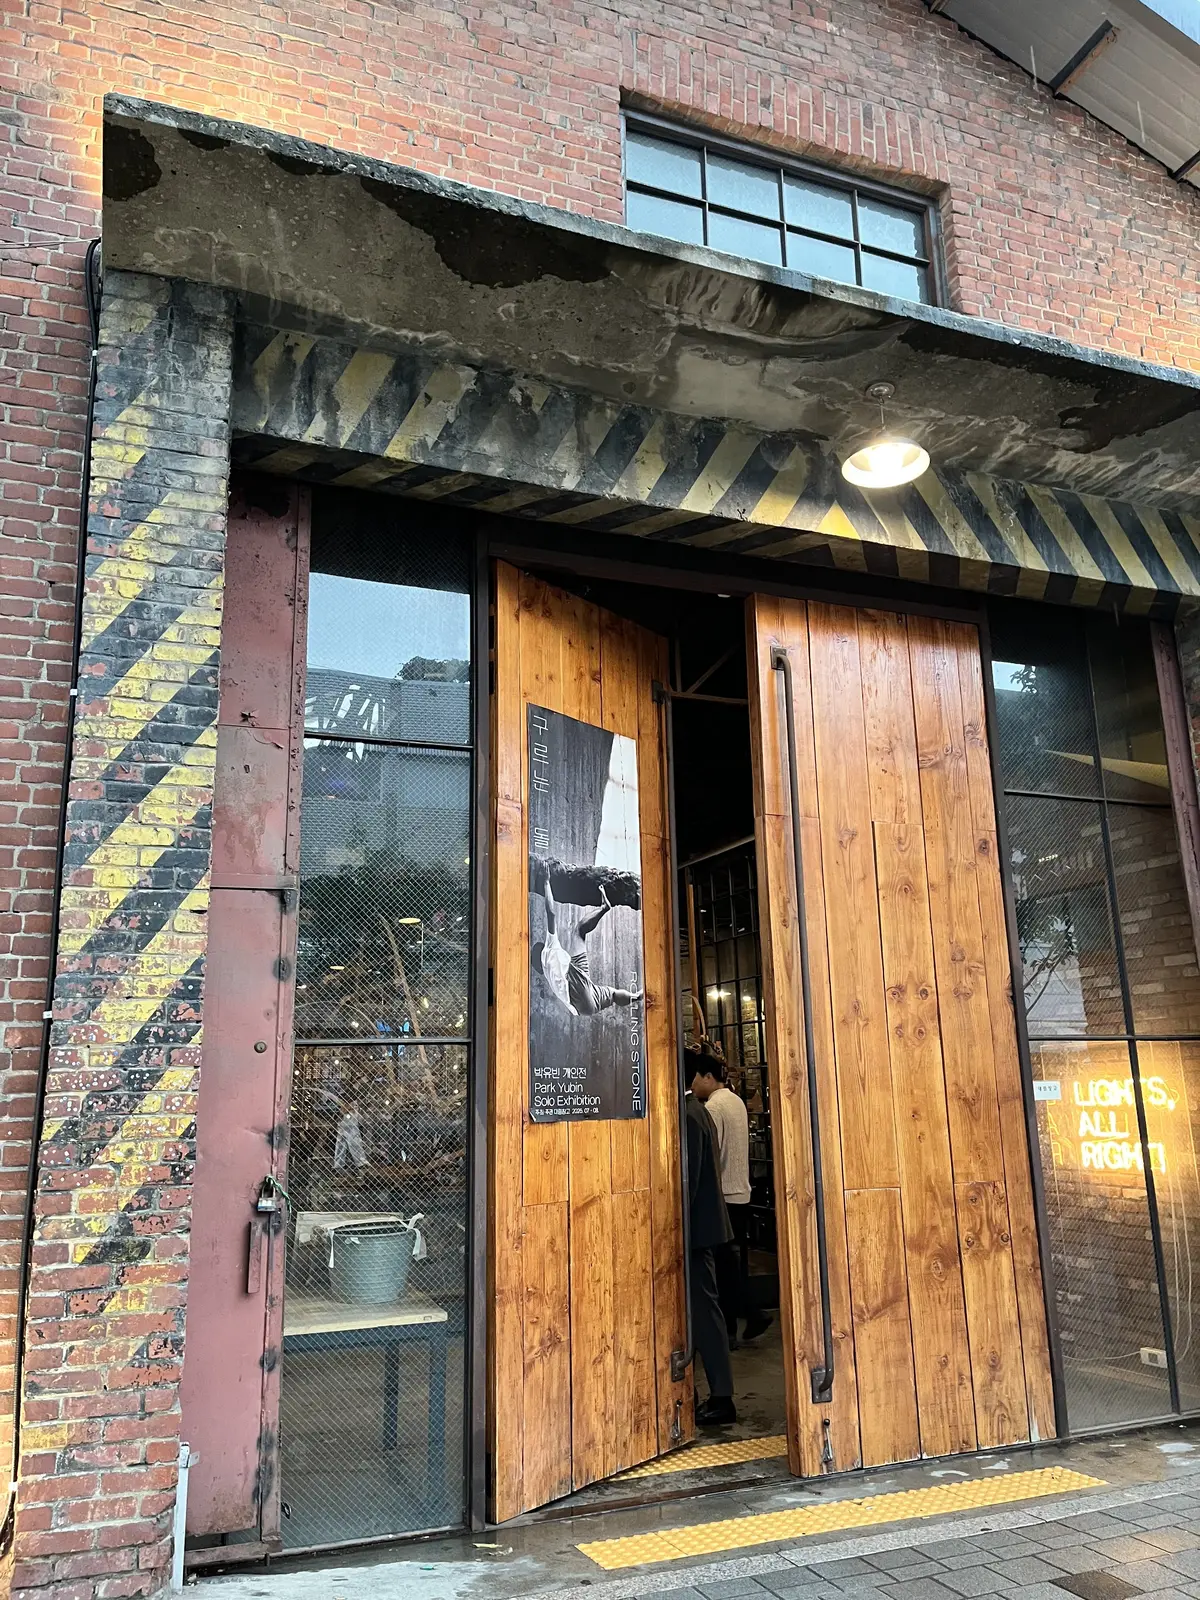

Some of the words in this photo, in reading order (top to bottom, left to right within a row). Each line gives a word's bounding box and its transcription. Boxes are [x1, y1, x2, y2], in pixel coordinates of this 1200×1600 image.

[629, 971, 640, 1046] ROLLING
[534, 1067, 560, 1079] 박유빈
[562, 1067, 587, 1079] 개인전
[630, 1050, 641, 1111] STONE
[534, 1082, 556, 1093] Park
[558, 1082, 583, 1093] Yubin
[534, 1095, 556, 1107] Solo
[557, 1094, 601, 1106] Exhibition
[1079, 1111, 1130, 1137] ALL
